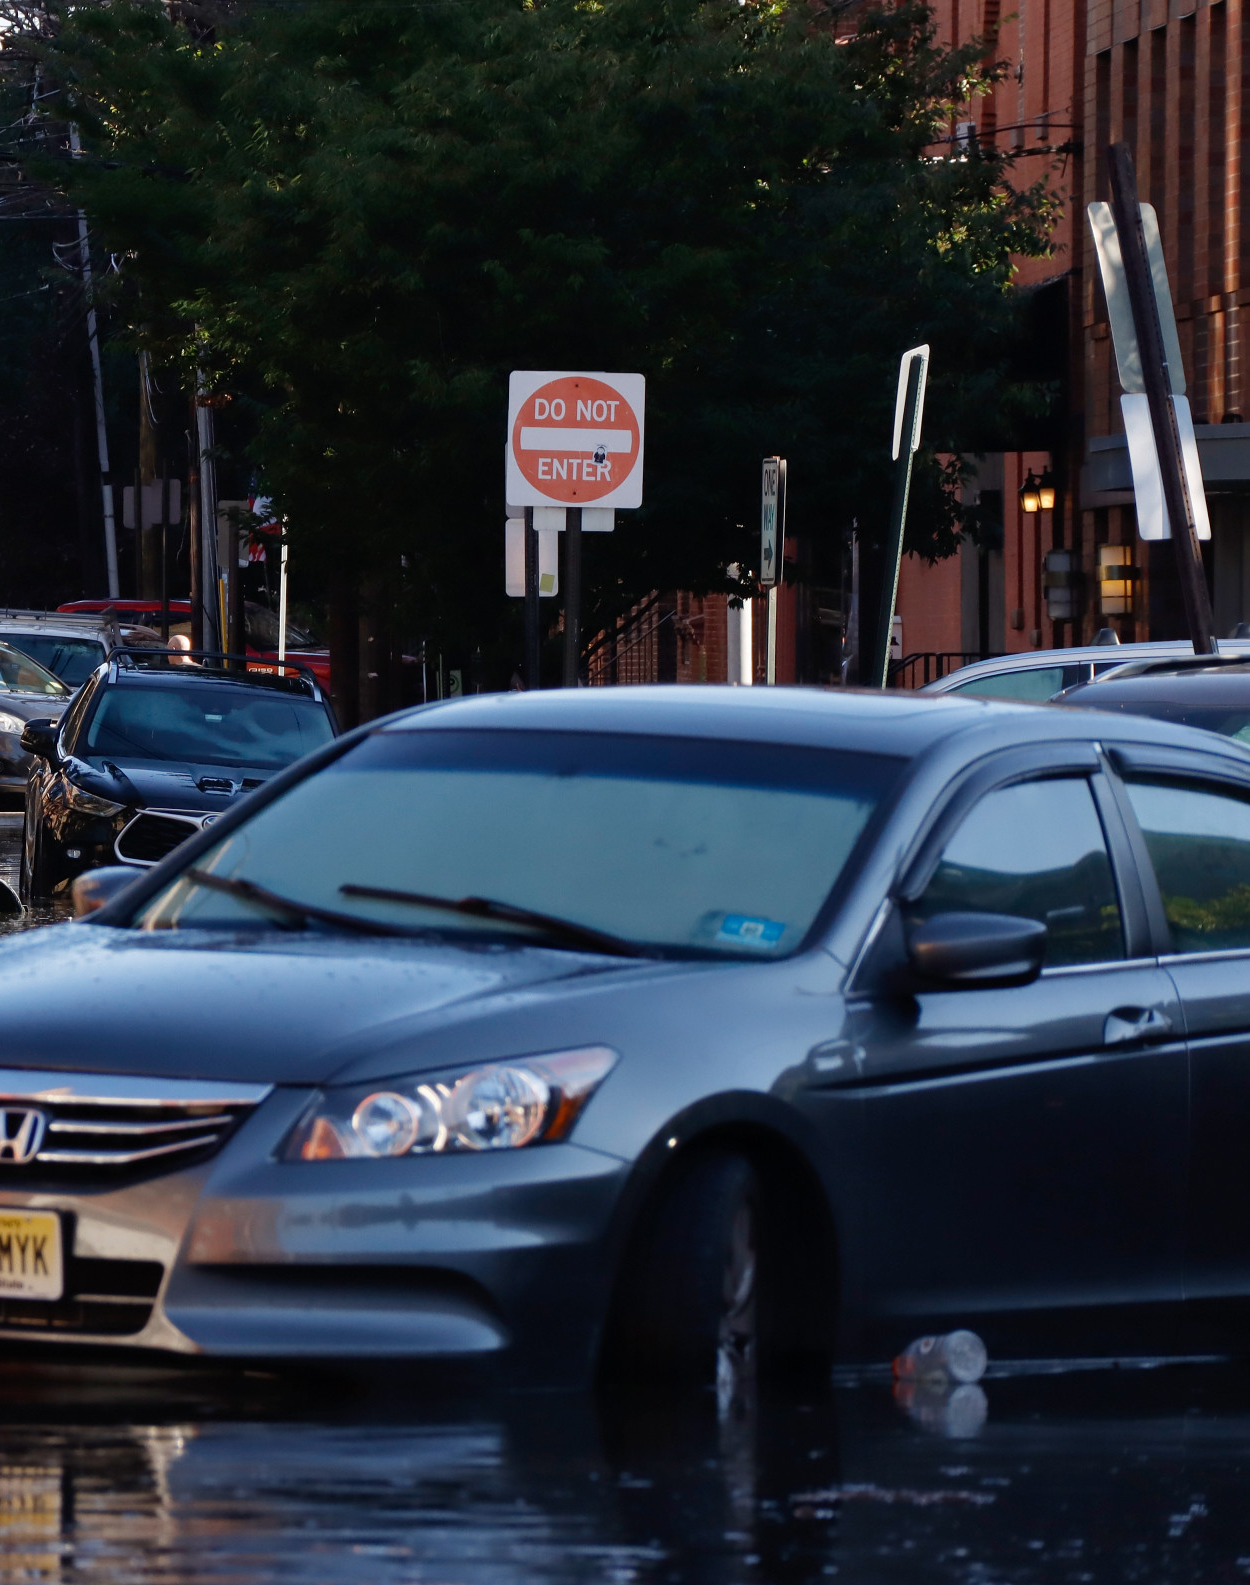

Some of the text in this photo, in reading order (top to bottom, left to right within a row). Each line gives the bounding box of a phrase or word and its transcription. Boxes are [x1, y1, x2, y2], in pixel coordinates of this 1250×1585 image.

[534, 398, 620, 422] DO NOT
[537, 457, 612, 482] ENTER
[764, 469, 776, 496] ONE
[763, 503, 775, 531] WAY
